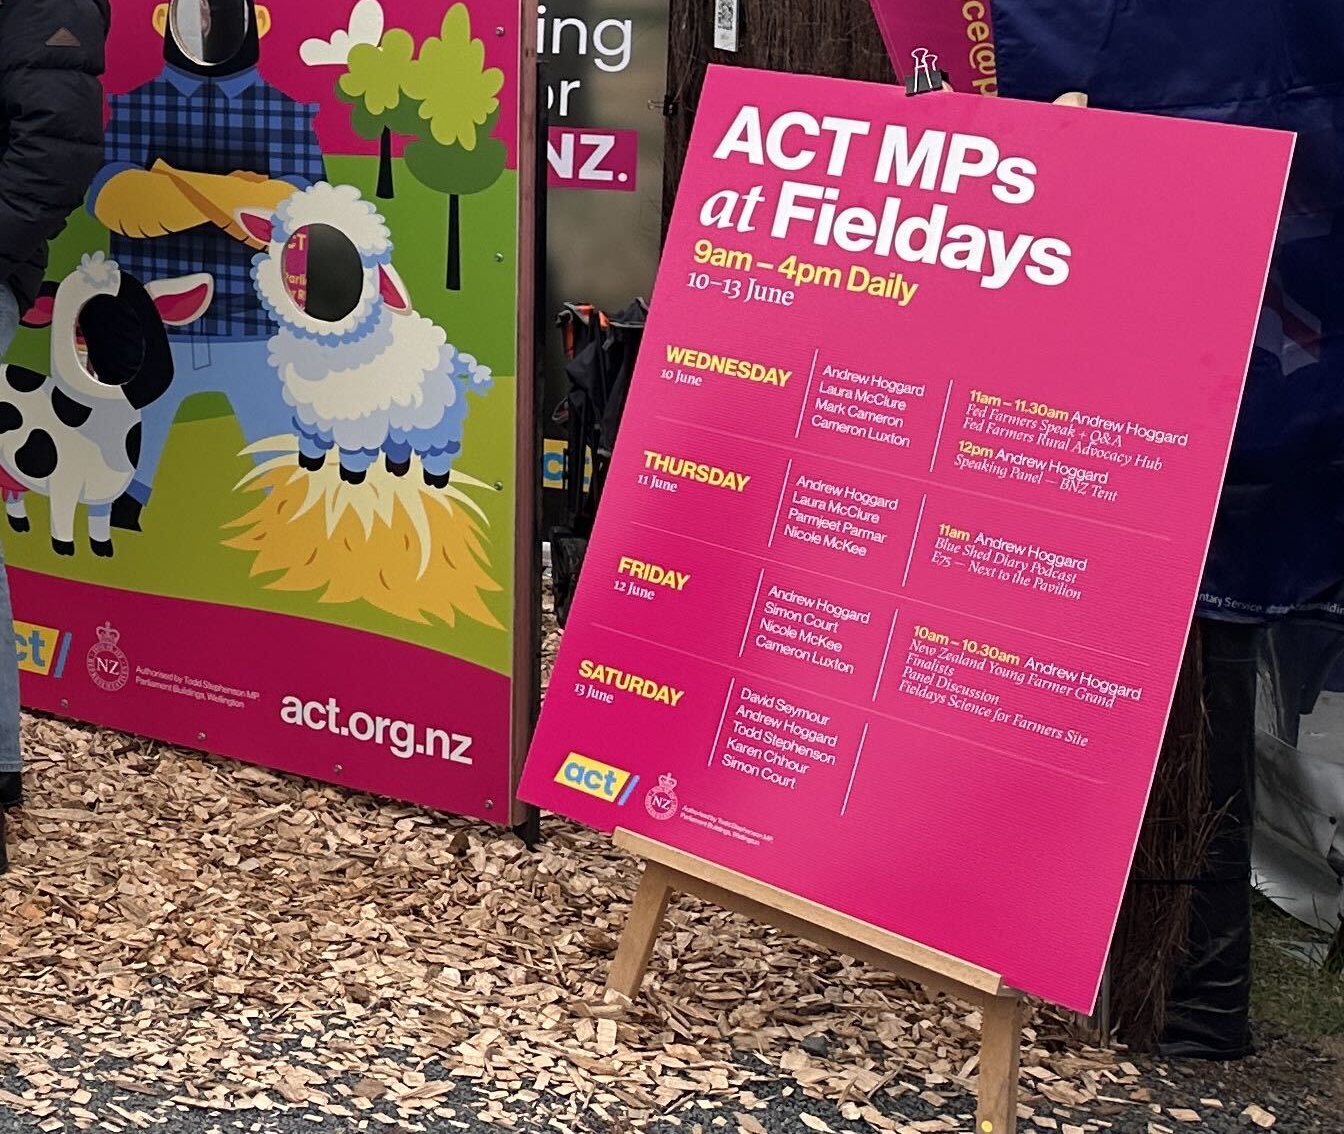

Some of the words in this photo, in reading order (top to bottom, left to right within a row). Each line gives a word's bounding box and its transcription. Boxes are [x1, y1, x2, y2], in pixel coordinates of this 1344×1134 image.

[547, 133, 628, 183] NZ.
[712, 105, 871, 177] ACT
[873, 124, 1037, 204] MPs
[699, 185, 766, 233] at
[770, 180, 1072, 289] Fieldays
[693, 239, 753, 272] 9am
[777, 255, 842, 288] 4pm
[846, 266, 919, 306] Daily
[743, 277, 795, 306] June
[660, 369, 674, 380] 10
[674, 369, 702, 386] June
[666, 344, 793, 387] WEDNESDAY
[822, 364, 870, 385] Andrew
[870, 374, 925, 397] Hoggard
[814, 397, 846, 415] Mark
[847, 404, 903, 428] Cameron
[818, 381, 853, 399] Laura
[854, 388, 907, 411] McClure
[811, 414, 867, 438] Cameron
[867, 426, 910, 447] Luxton
[965, 403, 988, 418] Fed
[988, 408, 1037, 429] Farmers
[1039, 419, 1075, 439] Speak
[1089, 430, 1121, 447] Q&A
[637, 474, 648, 485] 11
[649, 474, 678, 492] June
[643, 449, 751, 492] THURSDAY
[783, 523, 822, 544] Nicole
[822, 534, 867, 556] McKee
[787, 507, 841, 532] Parmjeet
[841, 521, 887, 543] Parmar
[617, 556, 691, 591] FRIDAY
[934, 536, 961, 553] Blue
[961, 544, 992, 561] Shed
[1029, 561, 1077, 583] Podcast
[613, 580, 626, 592] 12
[626, 581, 655, 600] June
[763, 601, 802, 622] Simon
[803, 612, 839, 633] Court
[96, 657, 121, 676] NZ
[905, 651, 955, 676] Finalists
[574, 682, 586, 696] 13
[585, 684, 614, 704] June
[578, 659, 685, 707] SATURDAY
[740, 687, 775, 708] David
[774, 698, 830, 726] Seymour
[280, 695, 473, 765] act.org.nz
[733, 719, 763, 740] Todd
[762, 731, 836, 765] Stephenson
[726, 736, 762, 759] Karen
[763, 749, 810, 774] Chhour
[564, 761, 617, 797] act
[651, 795, 672, 811] NZ
